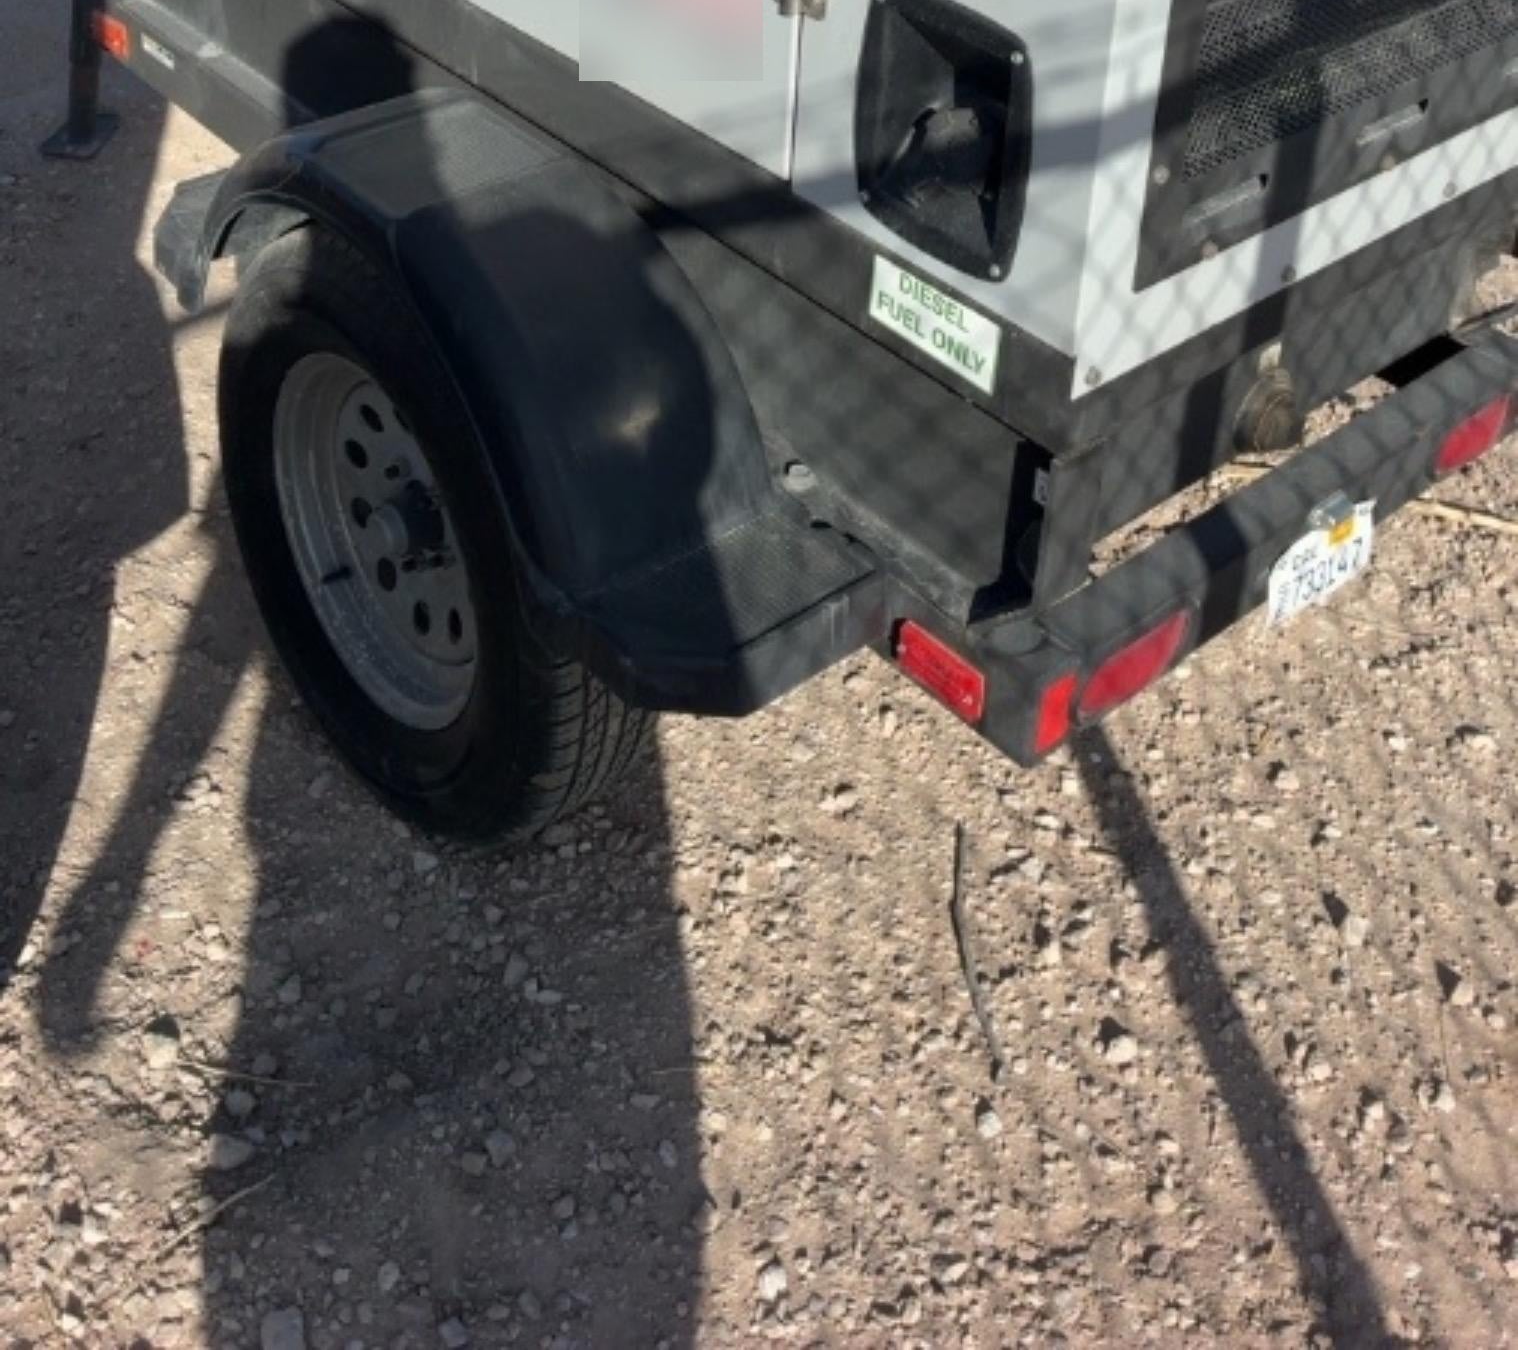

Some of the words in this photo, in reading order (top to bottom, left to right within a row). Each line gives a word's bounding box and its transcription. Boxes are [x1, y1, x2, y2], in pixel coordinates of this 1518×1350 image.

[877, 290, 926, 339] FUEL
[932, 328, 987, 375] ONLY
[899, 271, 970, 333] DIESEL
